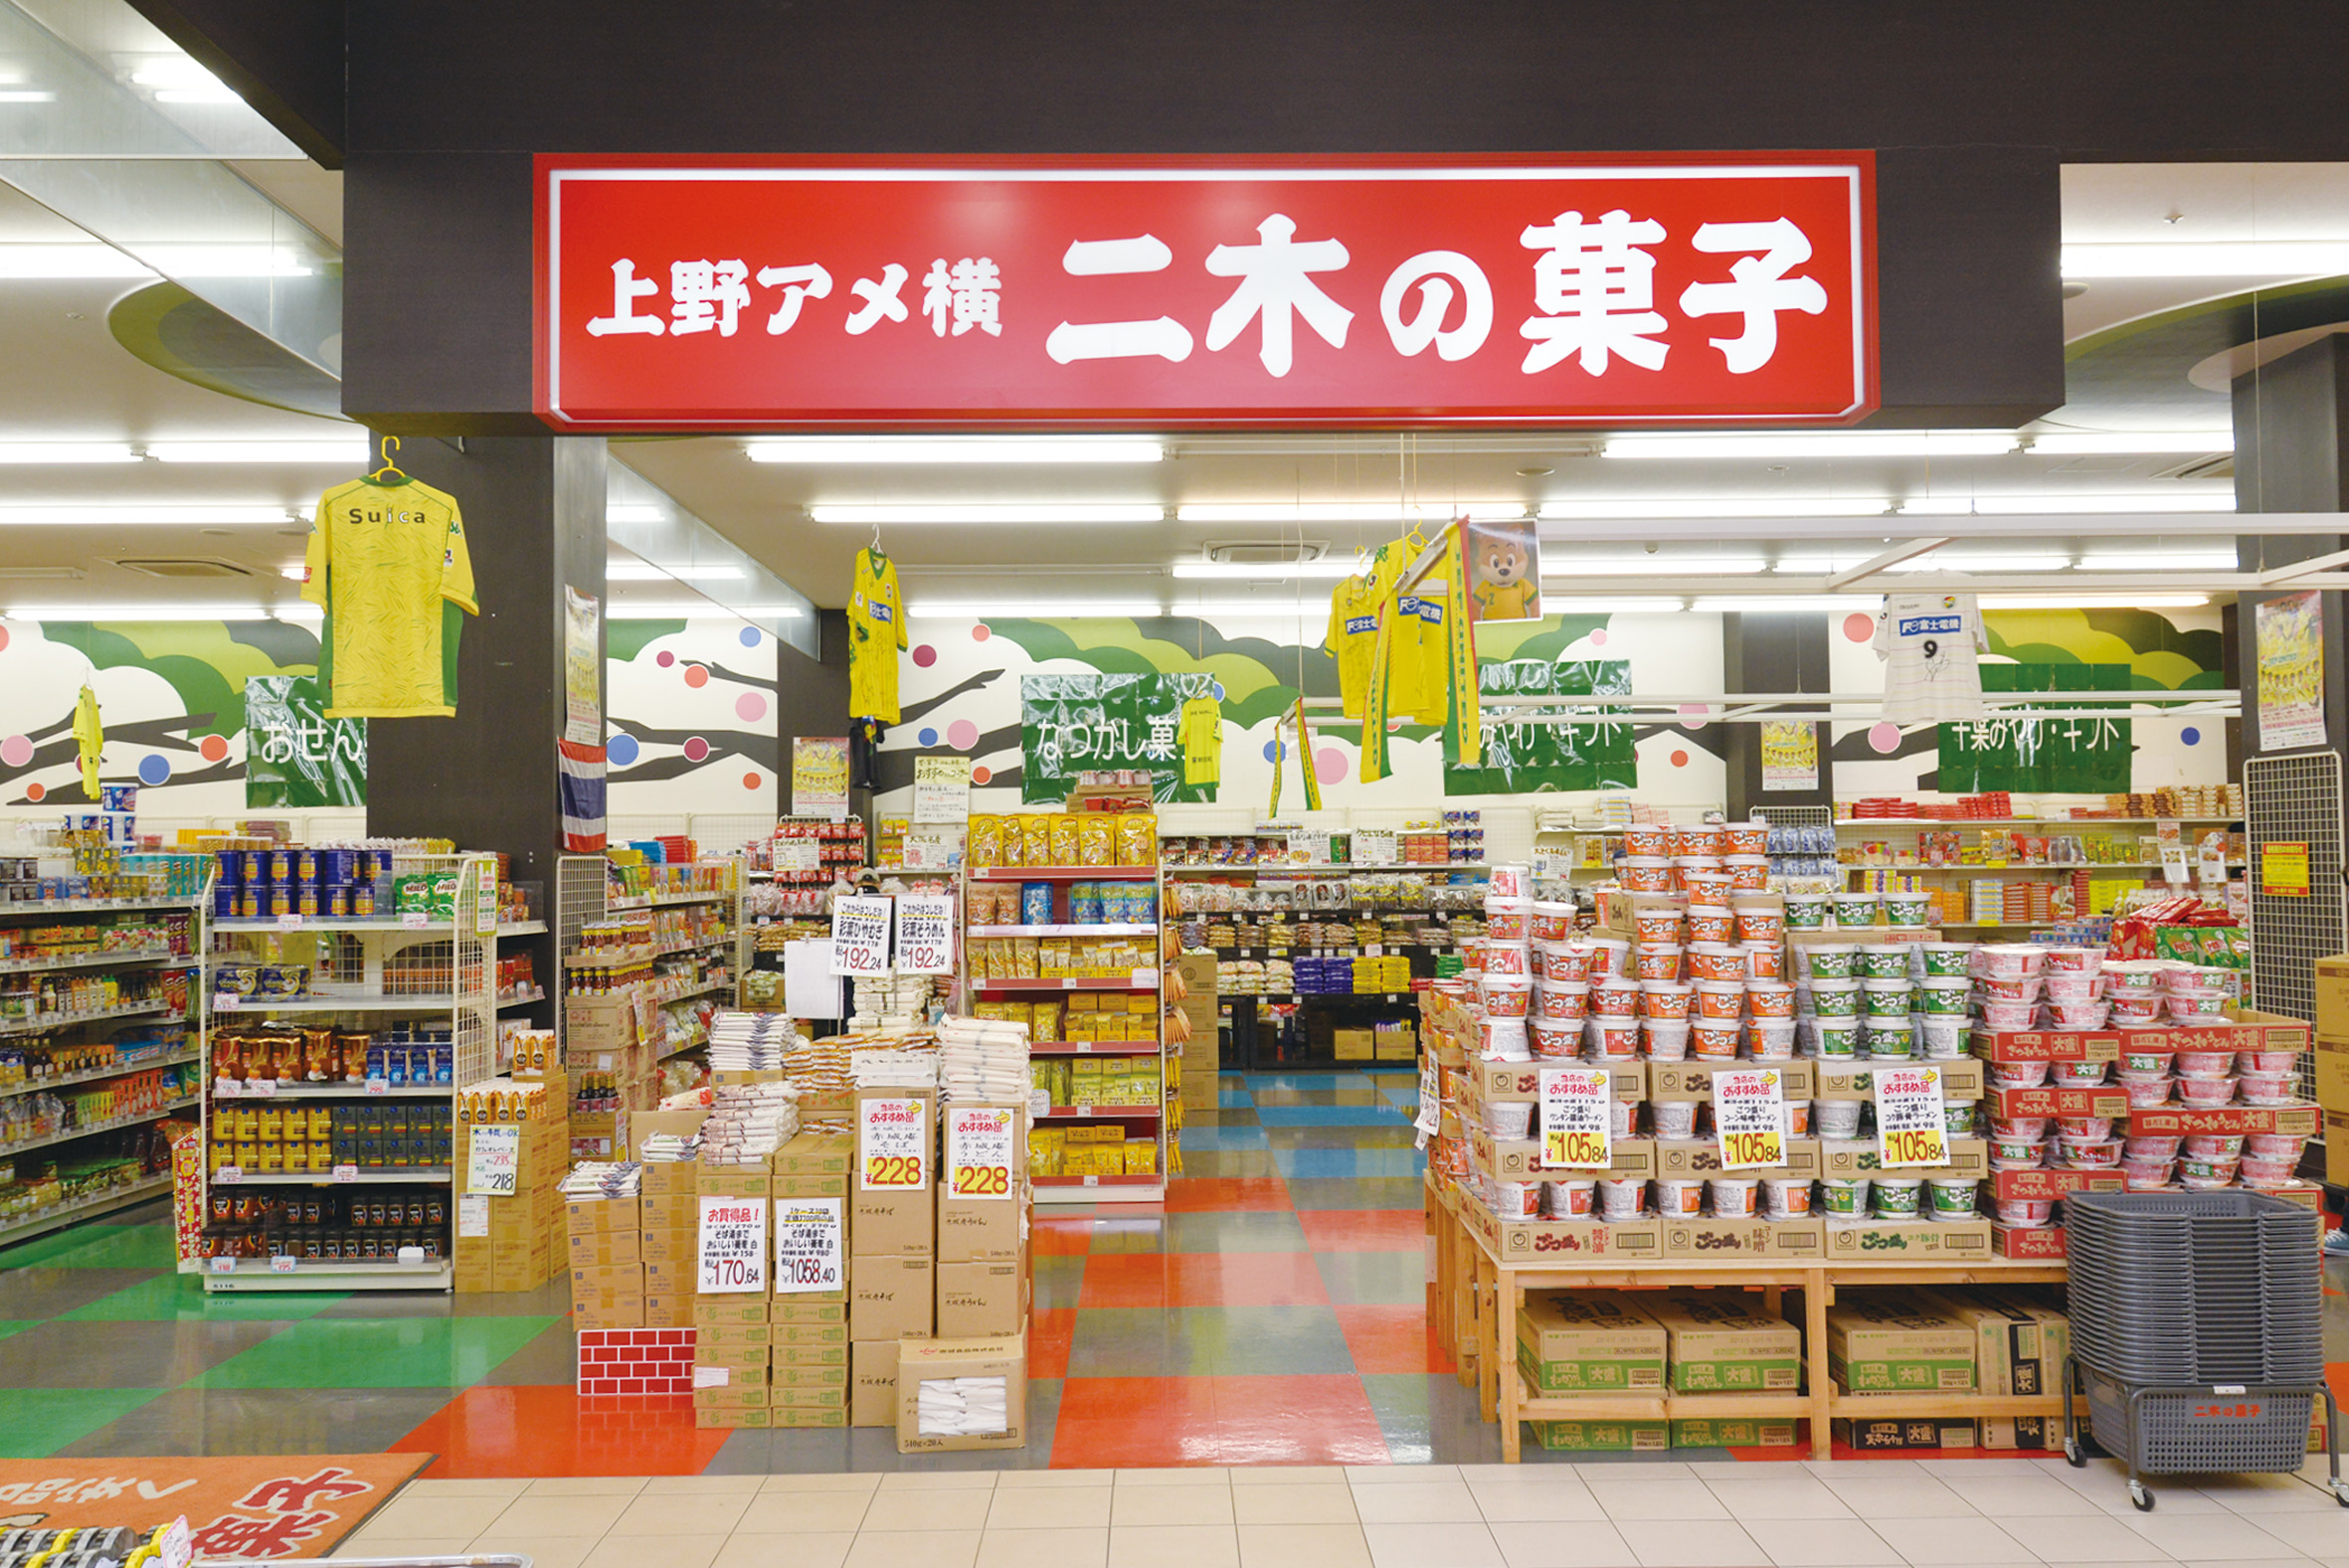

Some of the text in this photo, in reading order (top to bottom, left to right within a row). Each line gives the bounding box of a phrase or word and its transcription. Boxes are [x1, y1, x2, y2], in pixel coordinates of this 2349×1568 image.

[586, 209, 1829, 375] 上野アメ横 二木の菓子
[349, 508, 426, 524] Suica
[1923, 640, 1937, 658] 9
[262, 718, 367, 764] おせん
[1037, 718, 1185, 761] なつかし菓
[2055, 1037, 2078, 1053] 大盛
[2235, 1029, 2260, 1046] 大盛
[1549, 1083, 1598, 1095] おすすめ品
[1722, 1085, 1770, 1097] おすすめ品
[1884, 1082, 1930, 1095] おすすめ品
[2062, 1093, 2085, 1110] 大盛
[869, 1113, 914, 1124] おすすめ品
[2245, 1112, 2271, 1130] 大盛
[958, 1122, 1002, 1132] おすすめ品
[492, 1173, 514, 1190] 218
[2058, 1175, 2081, 1191] 大盛
[708, 1207, 759, 1223] お買得品！
[2194, 1404, 2261, 1418] 二木の菓子
